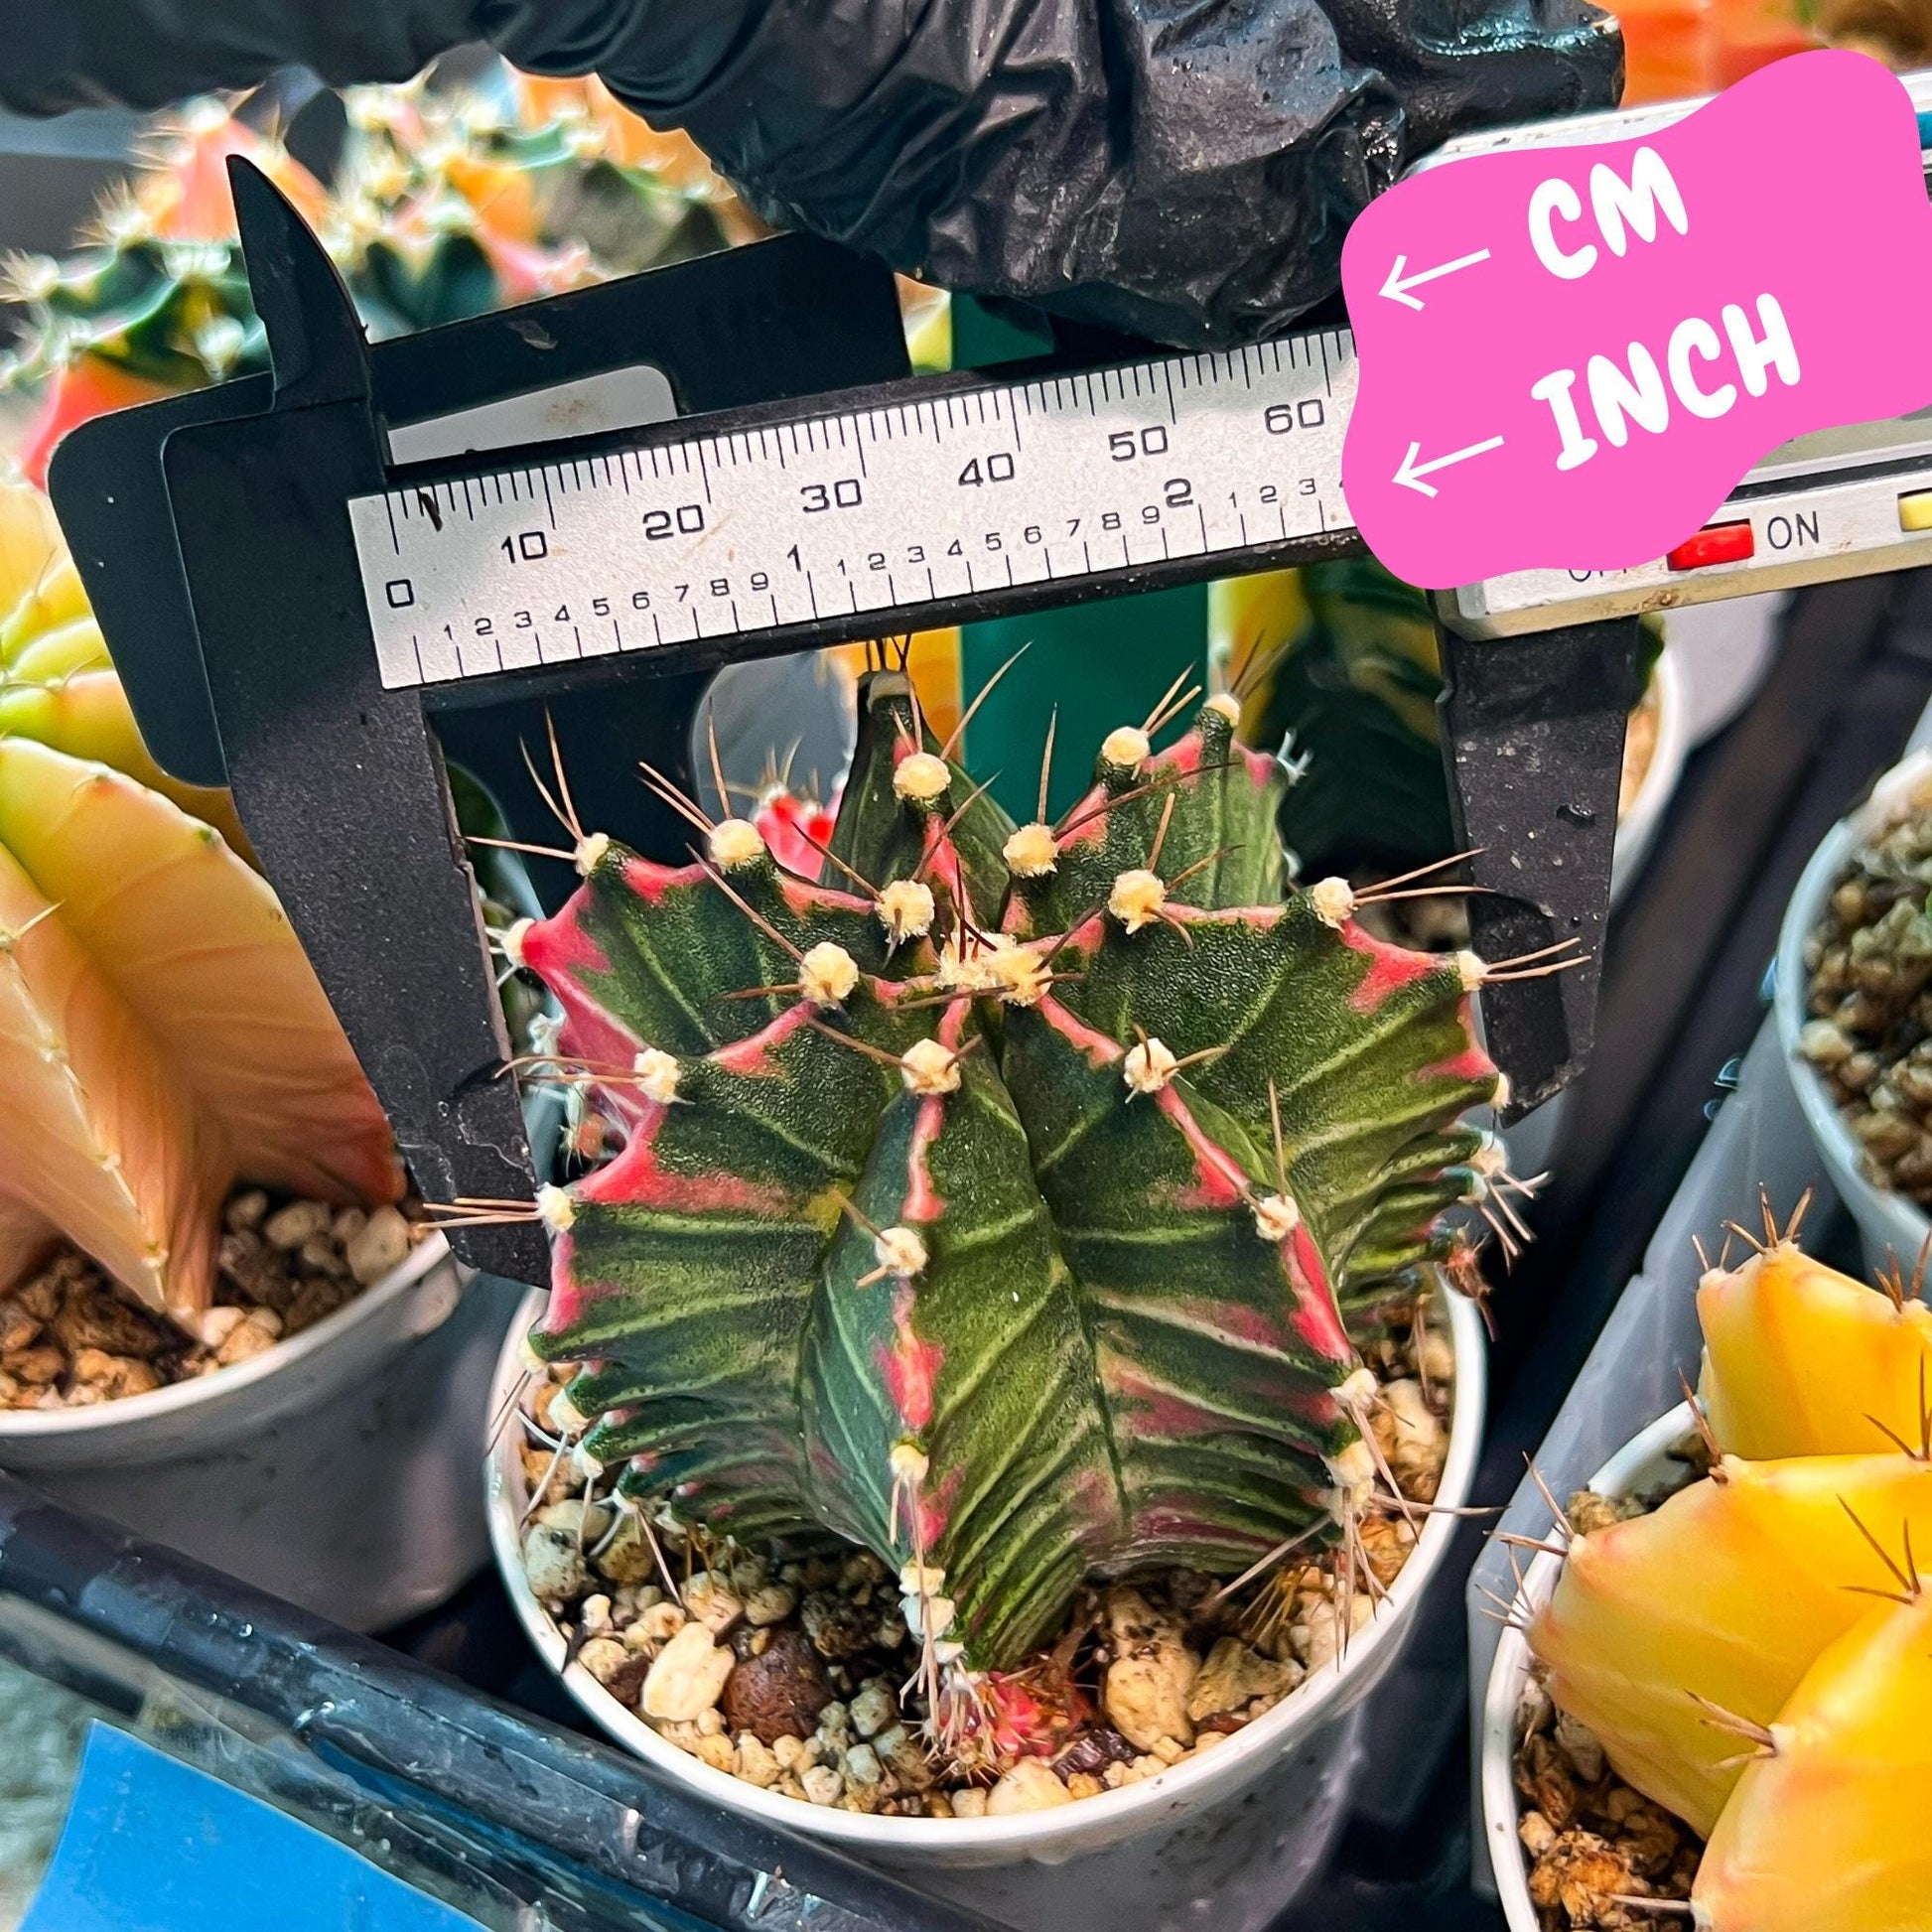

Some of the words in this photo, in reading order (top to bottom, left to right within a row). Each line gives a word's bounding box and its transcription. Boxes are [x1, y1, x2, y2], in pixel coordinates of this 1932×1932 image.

[385, 578, 415, 609] 0
[500, 530, 548, 564] 10
[642, 504, 705, 541] 20
[800, 479, 863, 513] 30
[958, 453, 1015, 487] 40
[1108, 425, 1169, 462] 50
[1264, 398, 1324, 435] 60
[444, 624, 453, 640] 1
[475, 618, 493, 636] 2
[513, 611, 532, 628] 3
[554, 605, 571, 621] 4
[592, 597, 611, 617] 5
[631, 591, 650, 610] 6
[674, 584, 689, 603] 7
[710, 578, 730, 597] 8
[751, 572, 769, 592] 9
[786, 544, 801, 572] 1
[837, 559, 846, 576] 1
[868, 552, 887, 571] 2
[907, 545, 925, 564] 3
[947, 539, 963, 556] 4
[985, 532, 1002, 551] 5
[1024, 525, 1042, 544] 6
[1066, 518, 1081, 537] 7
[1101, 511, 1122, 531] 8
[1141, 505, 1161, 524] 9
[1164, 478, 1194, 508] 2
[1228, 491, 1237, 508] 1
[1259, 484, 1278, 503] 2
[1299, 478, 1316, 496] 3
[1767, 510, 1820, 550] ON
